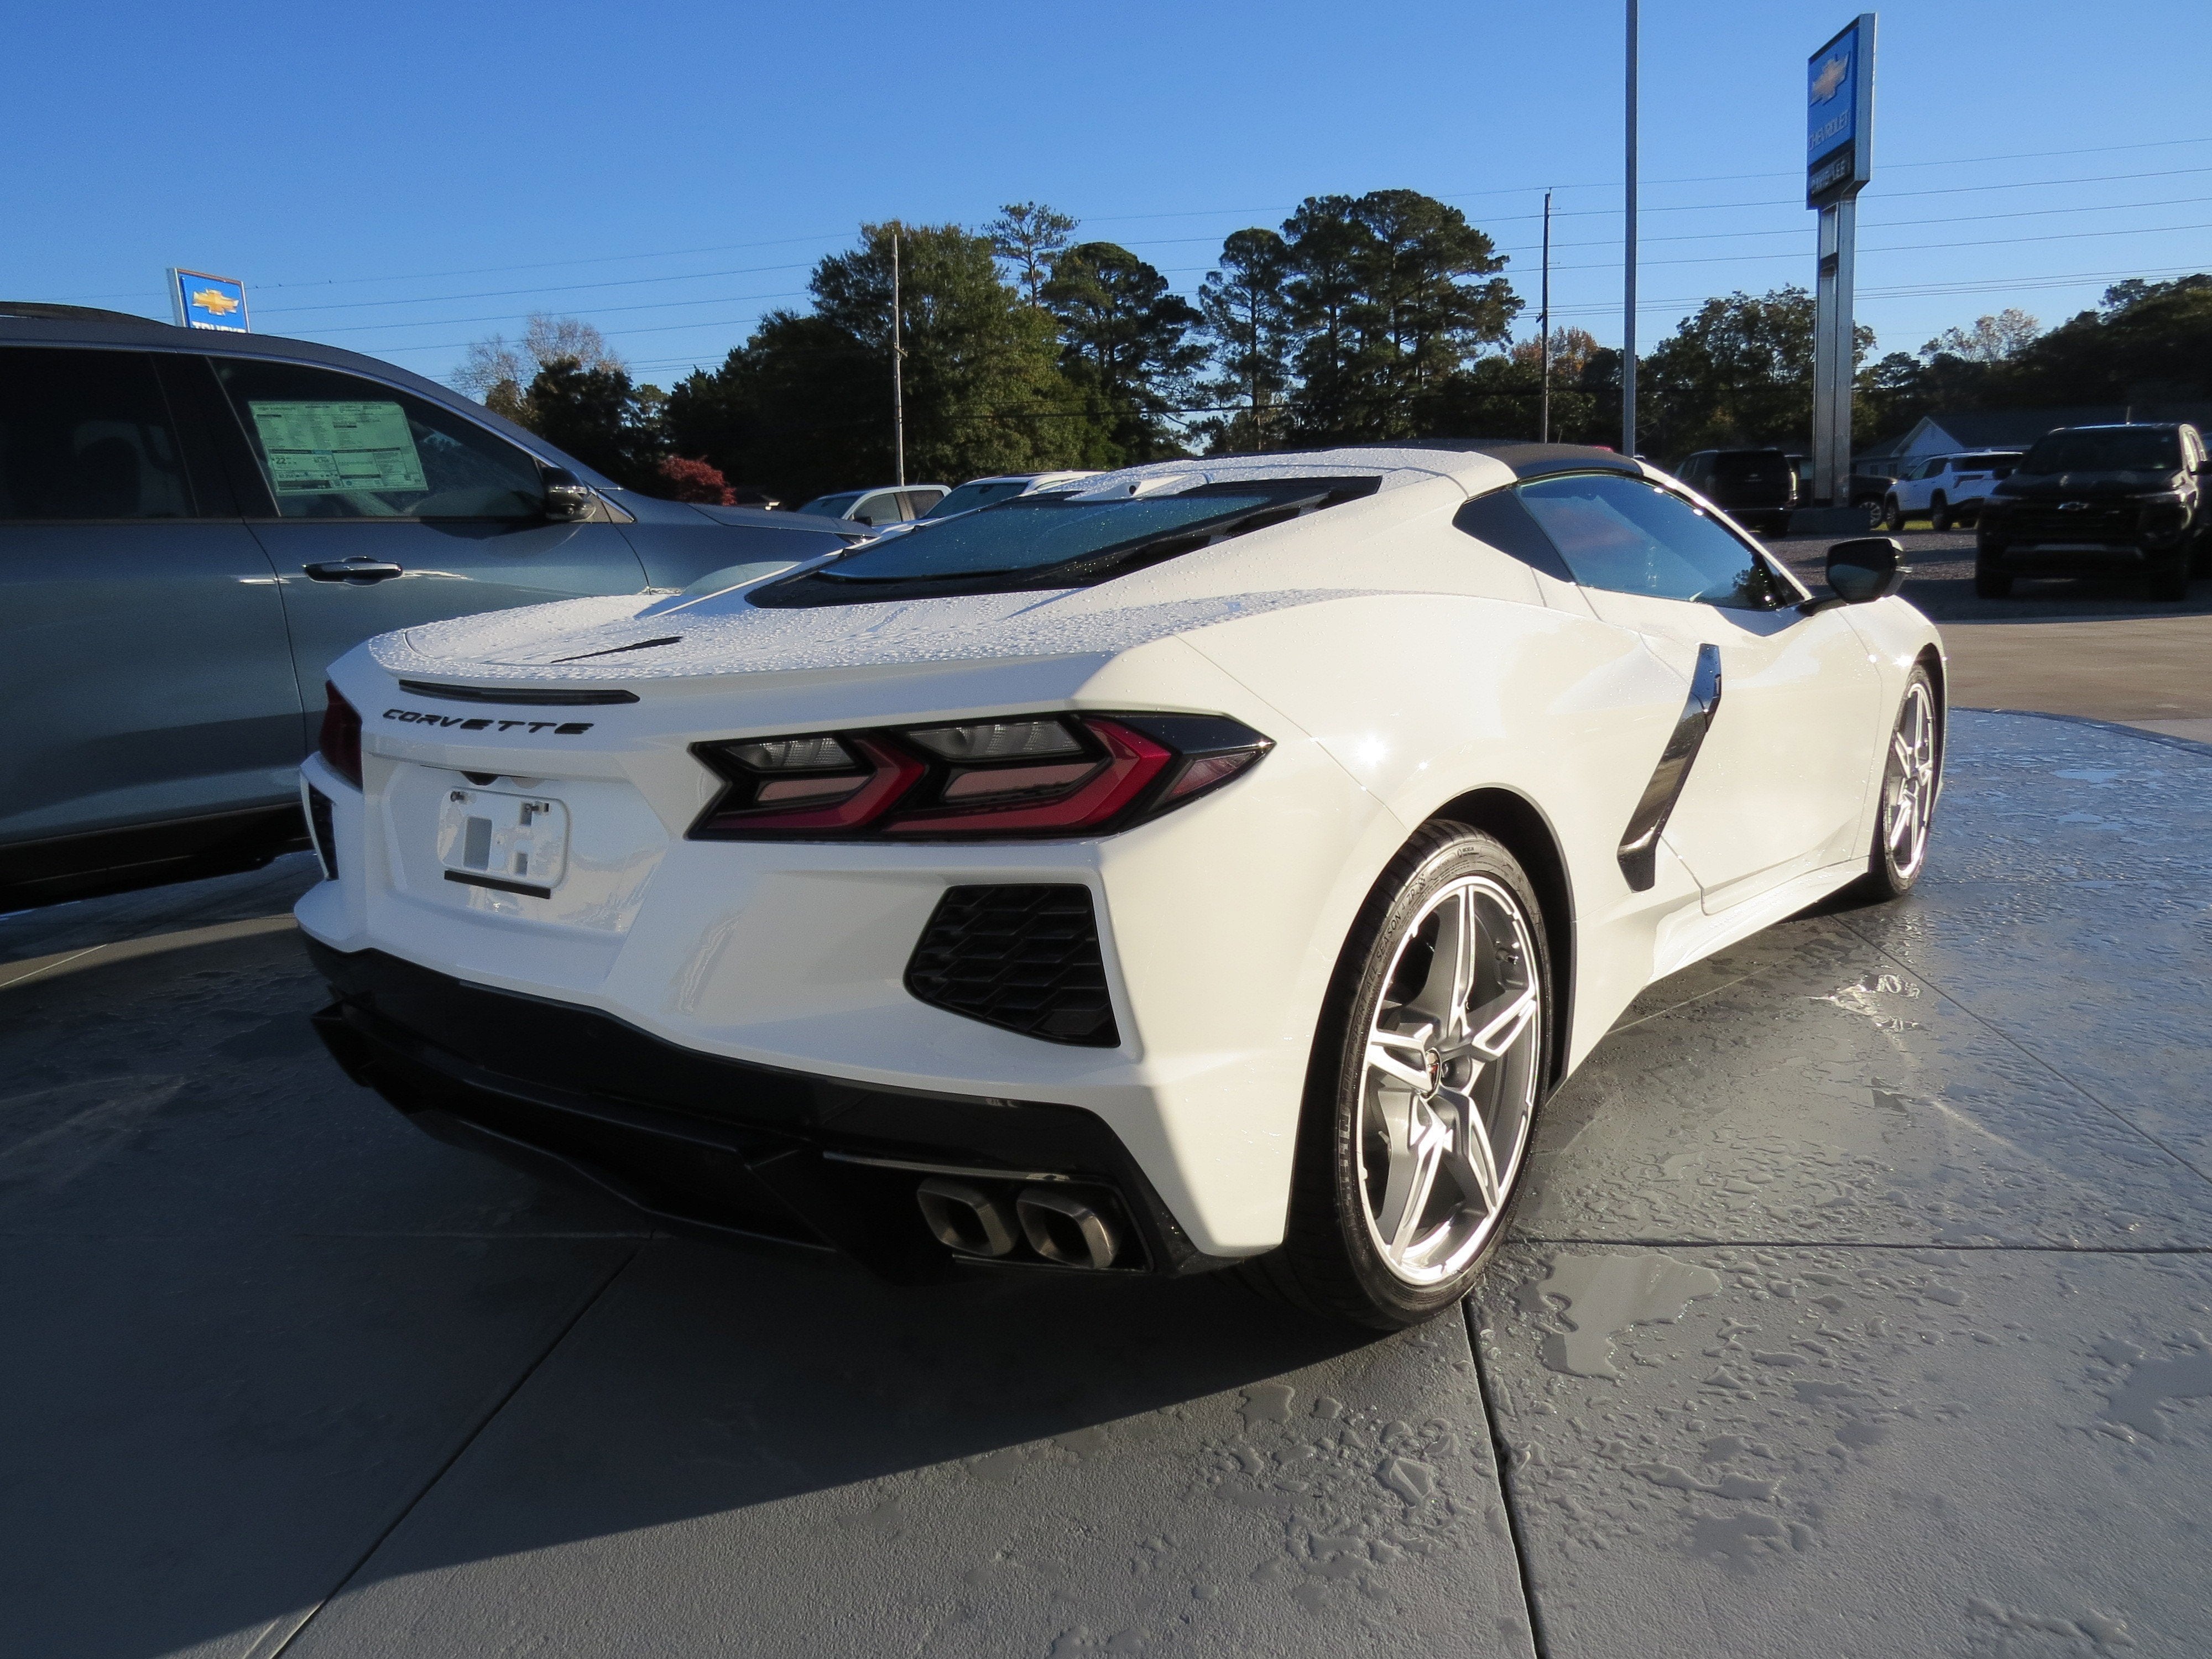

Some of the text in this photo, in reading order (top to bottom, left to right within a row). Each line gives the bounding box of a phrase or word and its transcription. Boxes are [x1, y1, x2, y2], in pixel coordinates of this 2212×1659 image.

[382, 709, 594, 734] CORVETTE
[1351, 997, 1367, 1044] SPORT
[1365, 967, 1378, 990] ALL
[1376, 911, 1402, 959] SEASON
